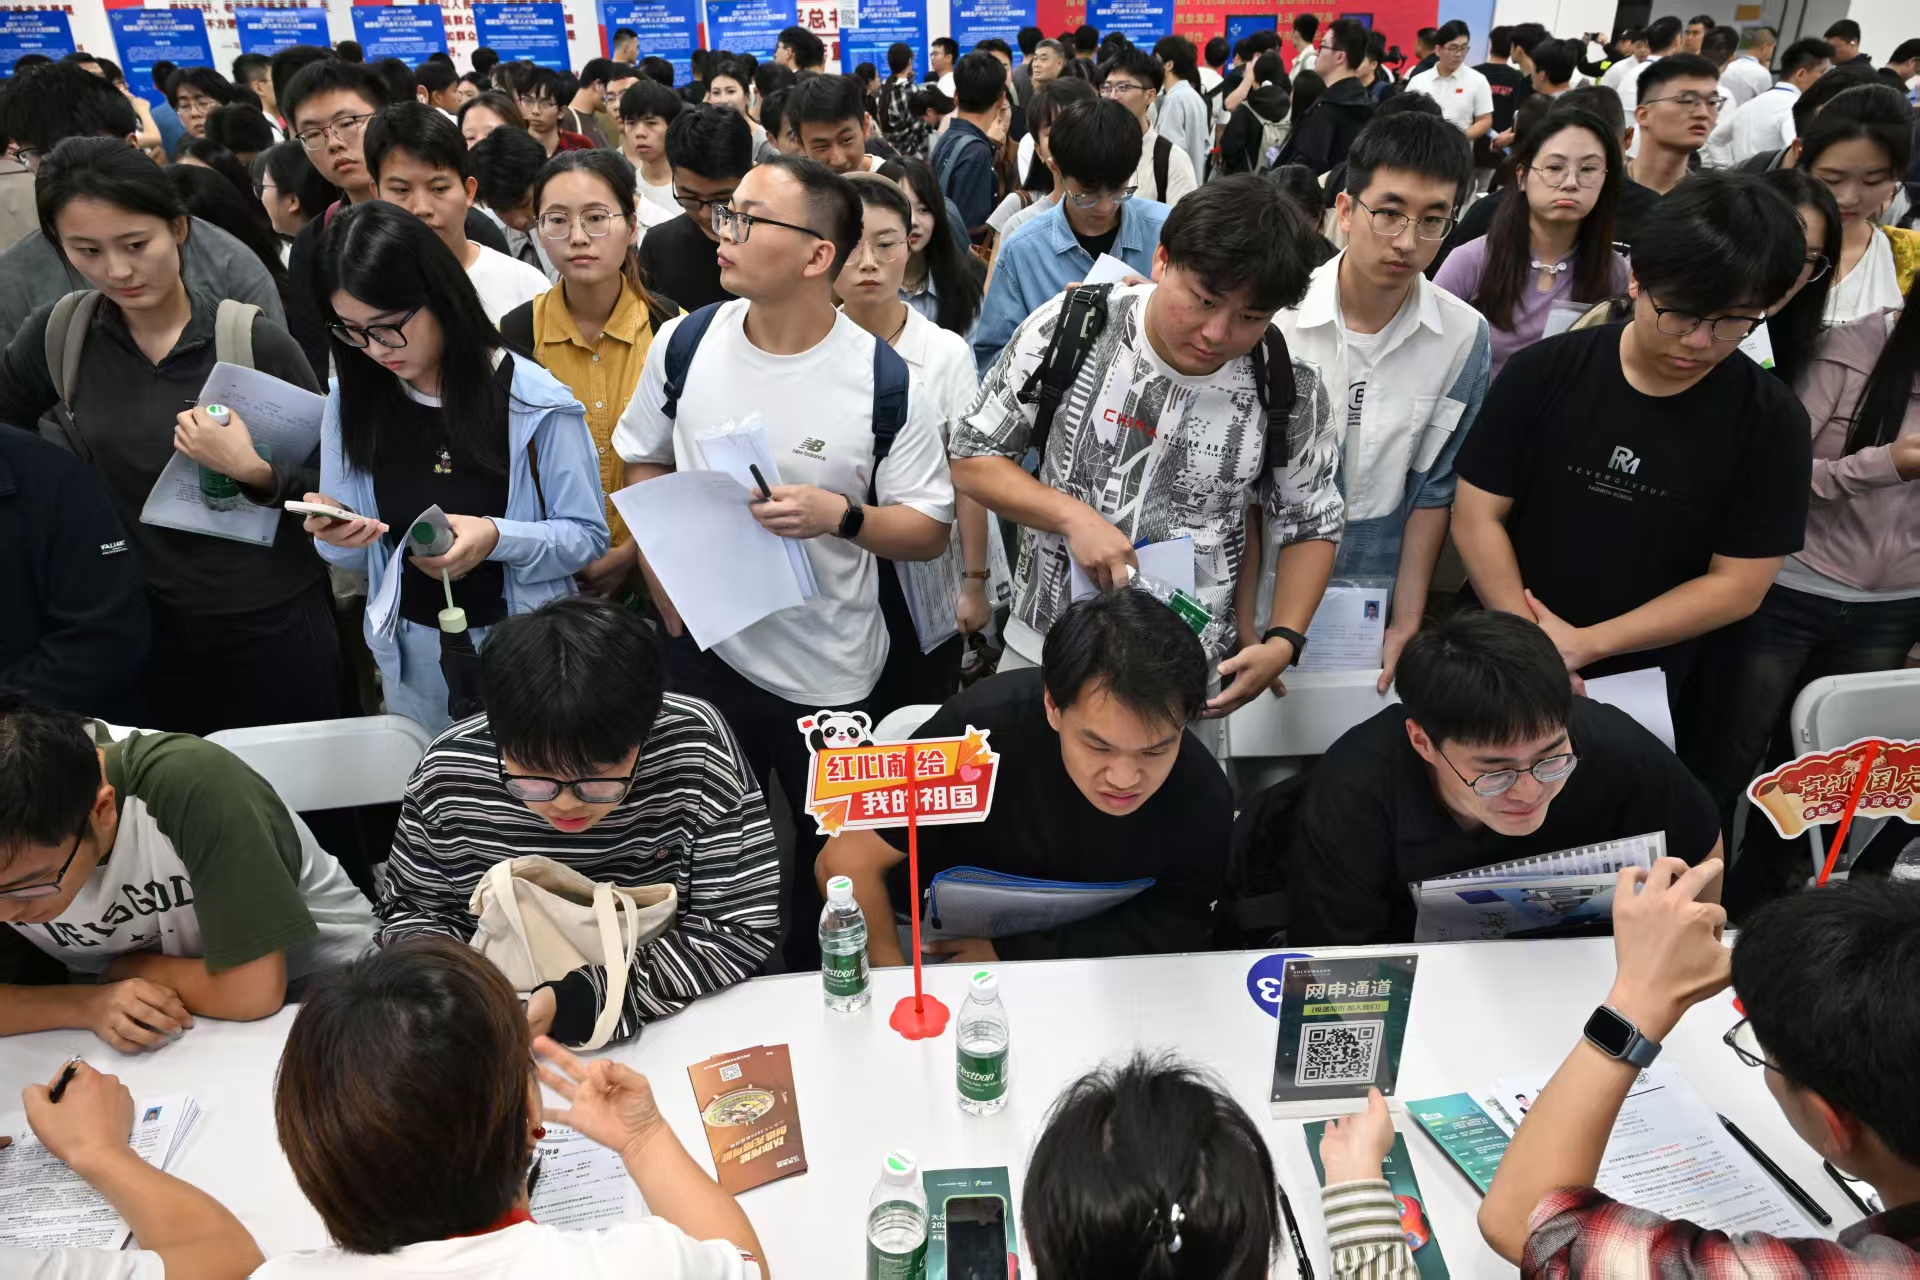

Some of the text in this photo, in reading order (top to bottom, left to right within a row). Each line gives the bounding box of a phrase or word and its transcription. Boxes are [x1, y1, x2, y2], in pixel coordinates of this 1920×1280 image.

[1103, 408, 1157, 439] CHINA
[803, 451, 827, 461] balance
[862, 784, 977, 816] 我的祖国
[1805, 797, 1911, 818] 盛世华喜迎华诞
[1304, 979, 1393, 1001] 网申通道
